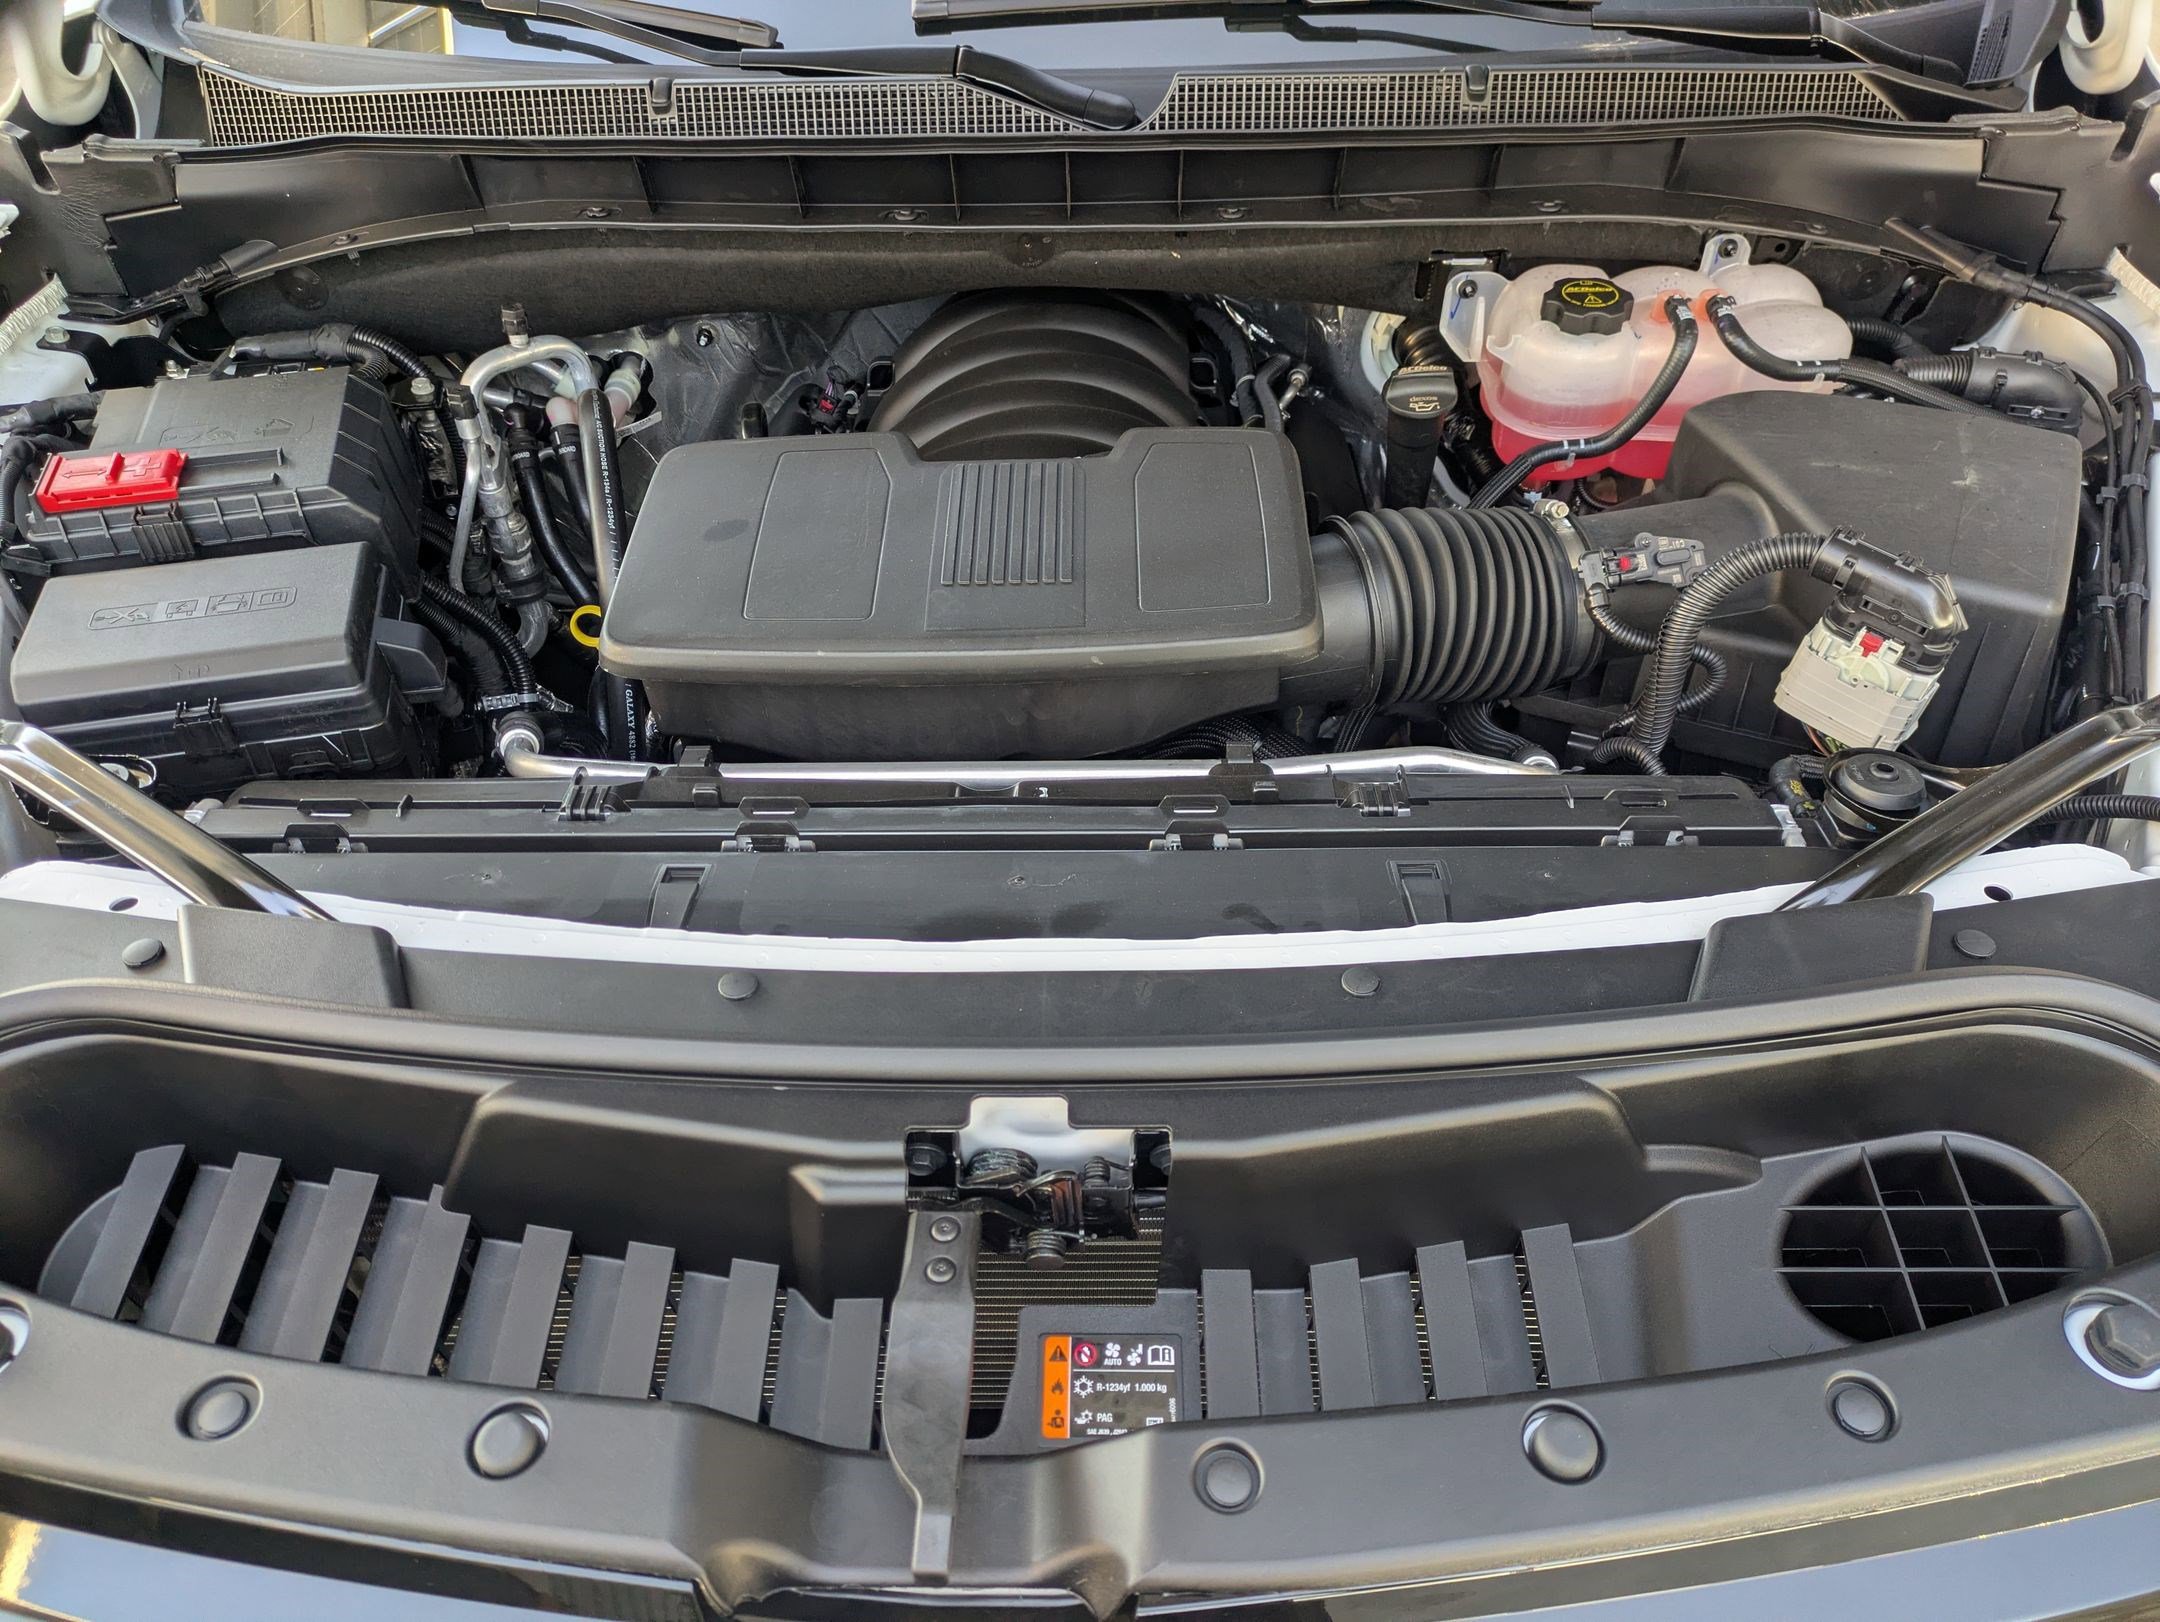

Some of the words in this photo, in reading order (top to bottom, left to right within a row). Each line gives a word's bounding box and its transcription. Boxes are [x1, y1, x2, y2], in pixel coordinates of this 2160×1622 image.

[1398, 364, 1448, 376] ACDelco
[625, 689, 636, 729] GALAXY
[628, 730, 637, 749] 4882
[1104, 1358, 1122, 1366] AUTO
[1096, 1383, 1131, 1394] R-1234yf
[1135, 1384, 1156, 1392] 1.000
[1157, 1383, 1168, 1394] kg
[1097, 1413, 1113, 1423] PAG
